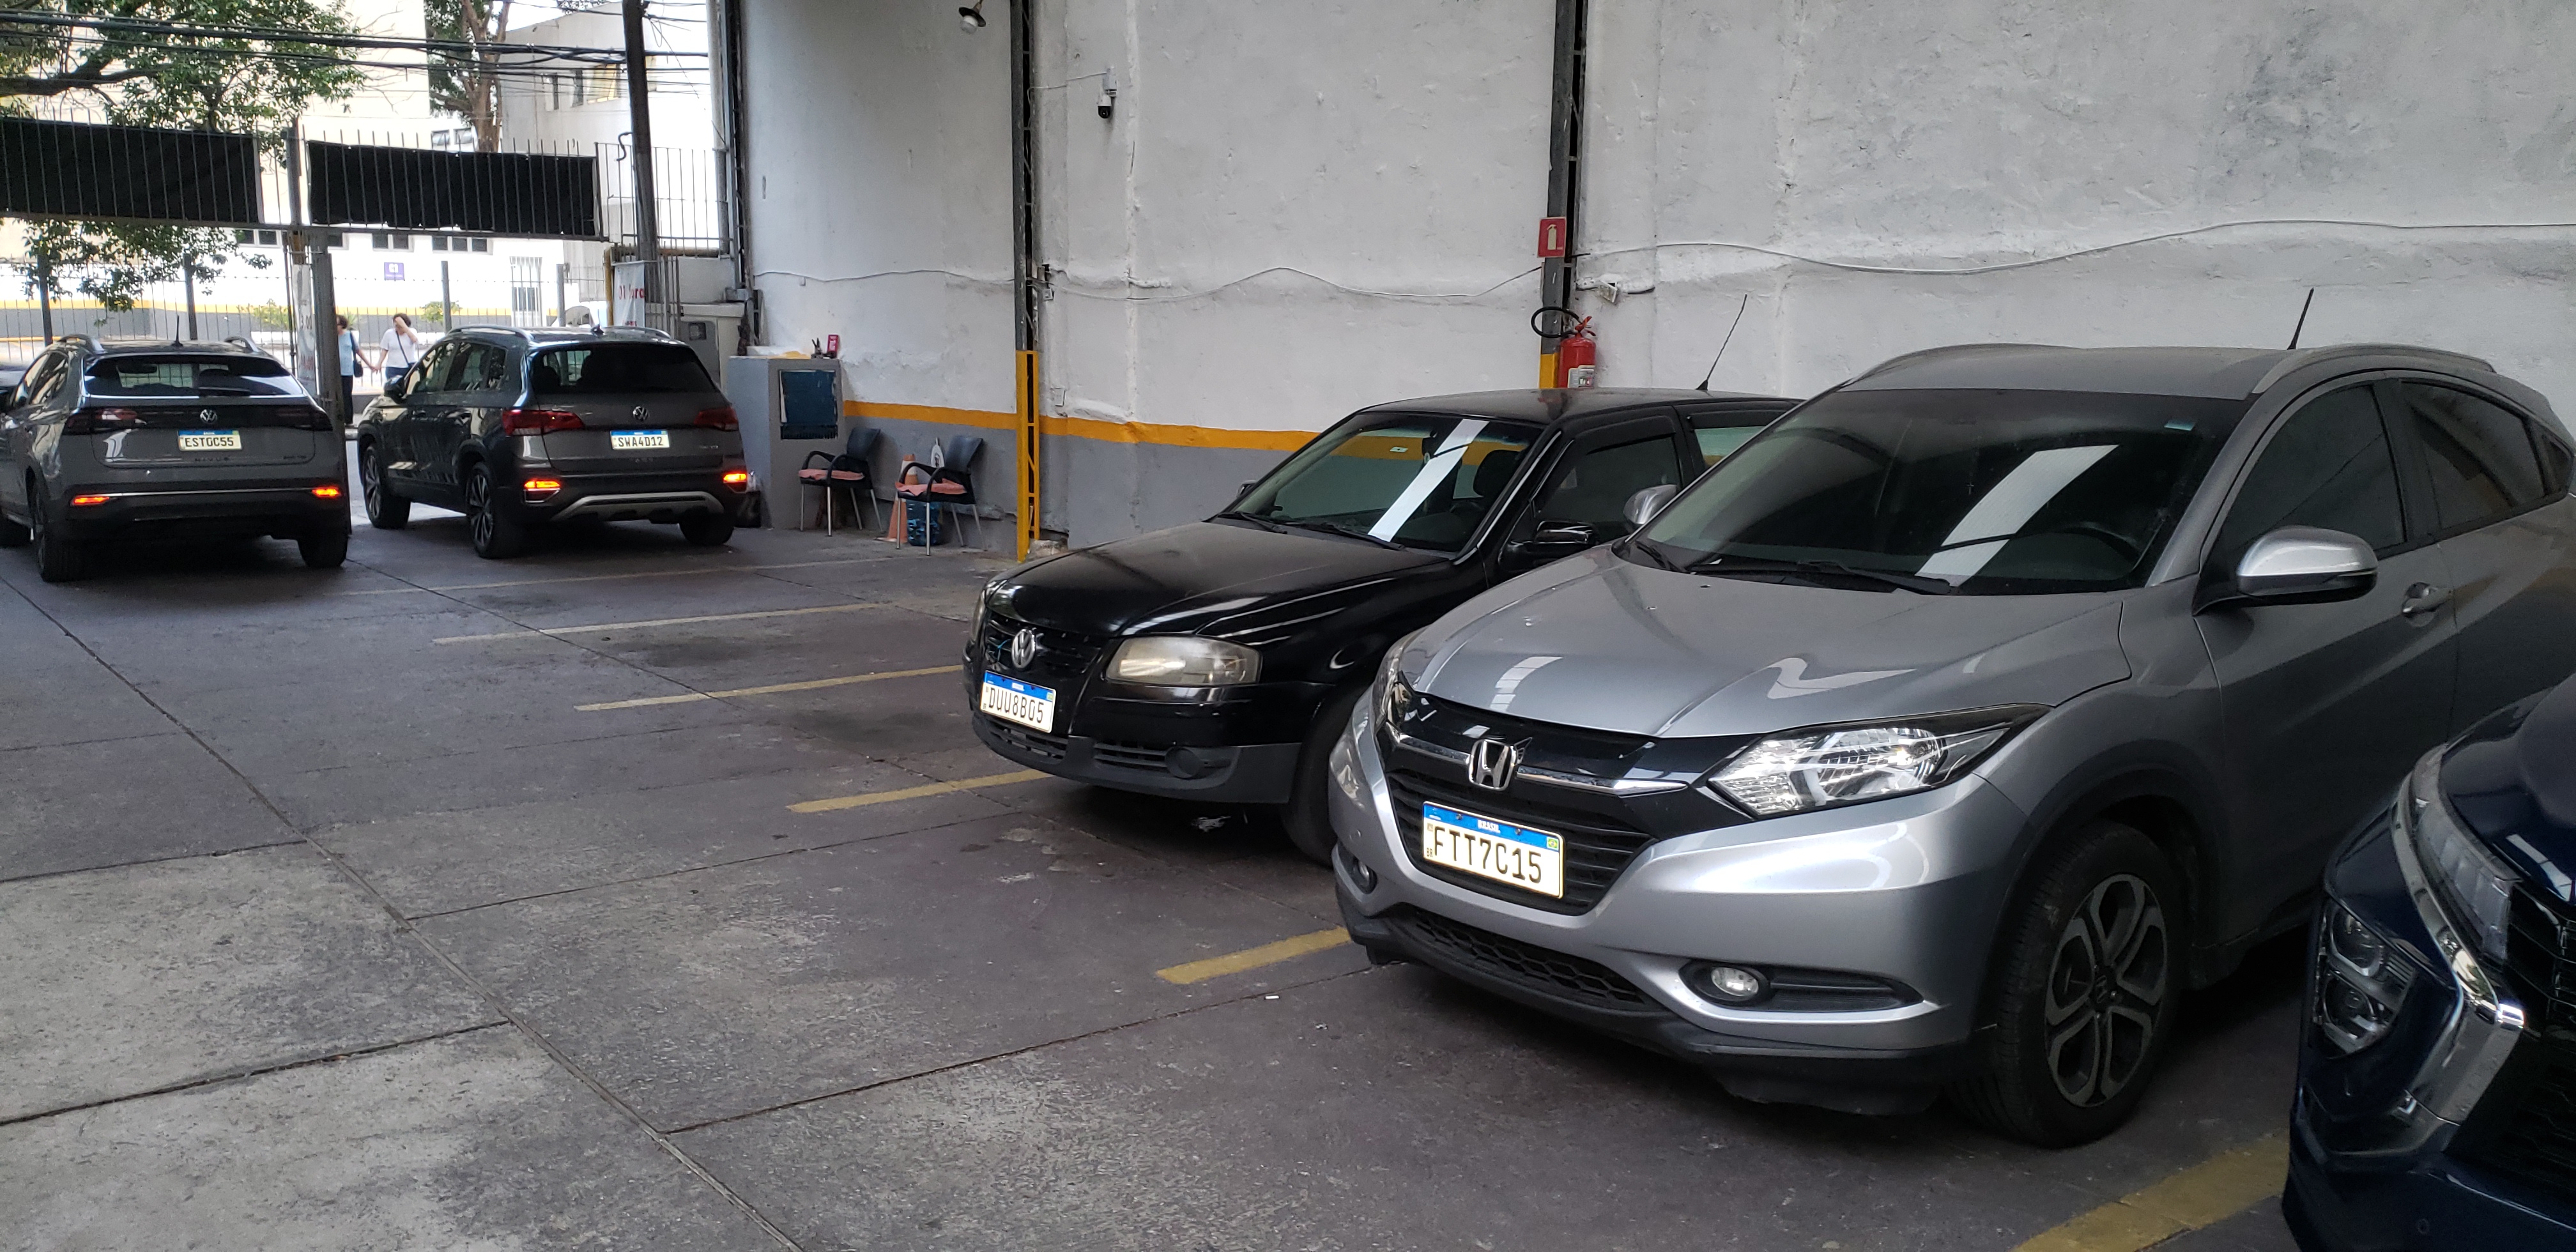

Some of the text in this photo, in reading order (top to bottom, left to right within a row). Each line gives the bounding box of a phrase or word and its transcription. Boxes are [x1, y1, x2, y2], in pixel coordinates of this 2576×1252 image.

[618, 436, 664, 447] SWA4D12
[988, 687, 1045, 724] DUU8B05
[1434, 825, 1542, 884] FTT7C15
